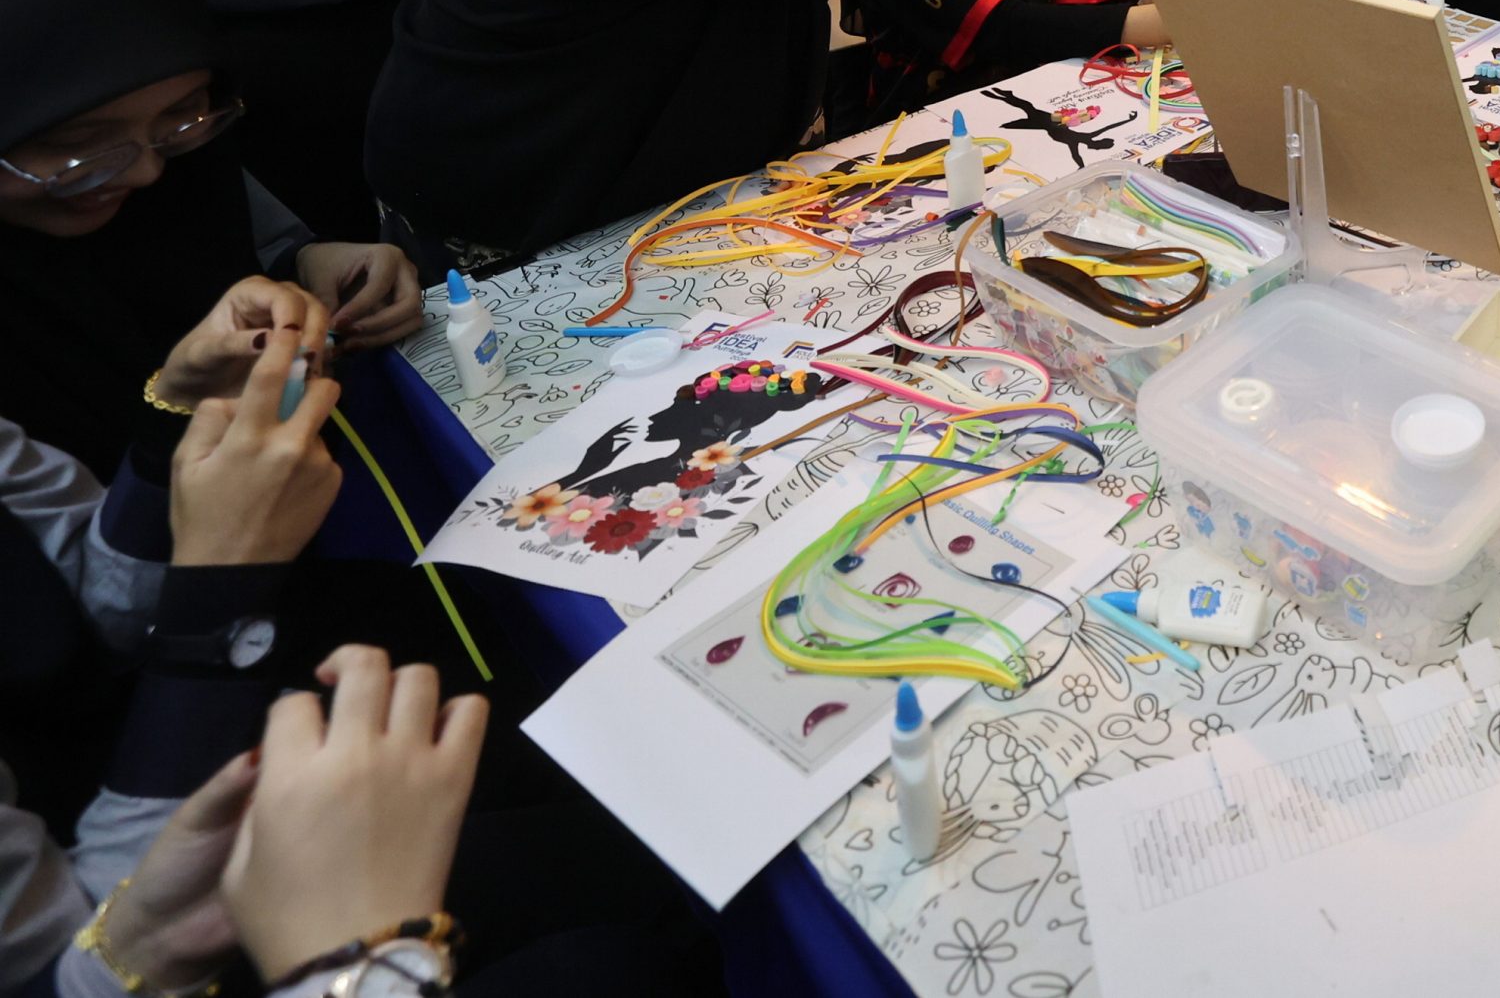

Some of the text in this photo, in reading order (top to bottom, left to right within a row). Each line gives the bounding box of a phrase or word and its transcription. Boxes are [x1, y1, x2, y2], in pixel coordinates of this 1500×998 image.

[1134, 127, 1176, 148] IDEA
[719, 337, 760, 351] IDEA
[962, 509, 1000, 535] Quilling
[1000, 531, 1036, 555] Shapes
[519, 539, 565, 560] Quilling
